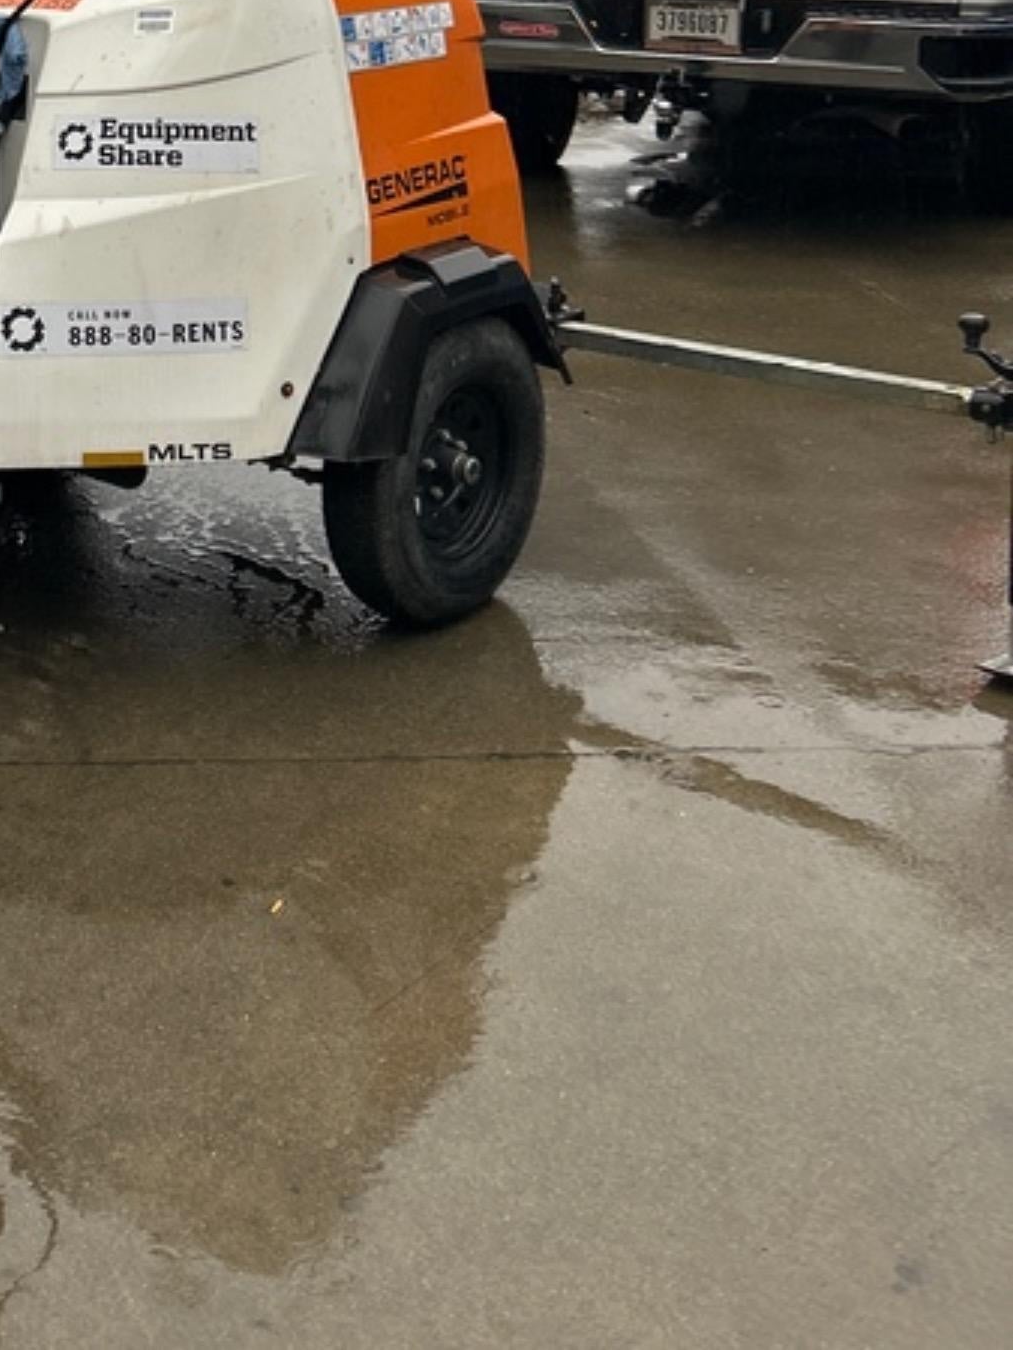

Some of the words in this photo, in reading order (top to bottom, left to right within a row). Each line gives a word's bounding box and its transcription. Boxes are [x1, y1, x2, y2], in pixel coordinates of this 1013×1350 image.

[99, 117, 257, 144] Equipment
[98, 144, 183, 166] Share
[367, 155, 466, 205] GENERAC
[68, 320, 244, 346] 888-80-RENTS
[149, 444, 232, 460] MLTS
